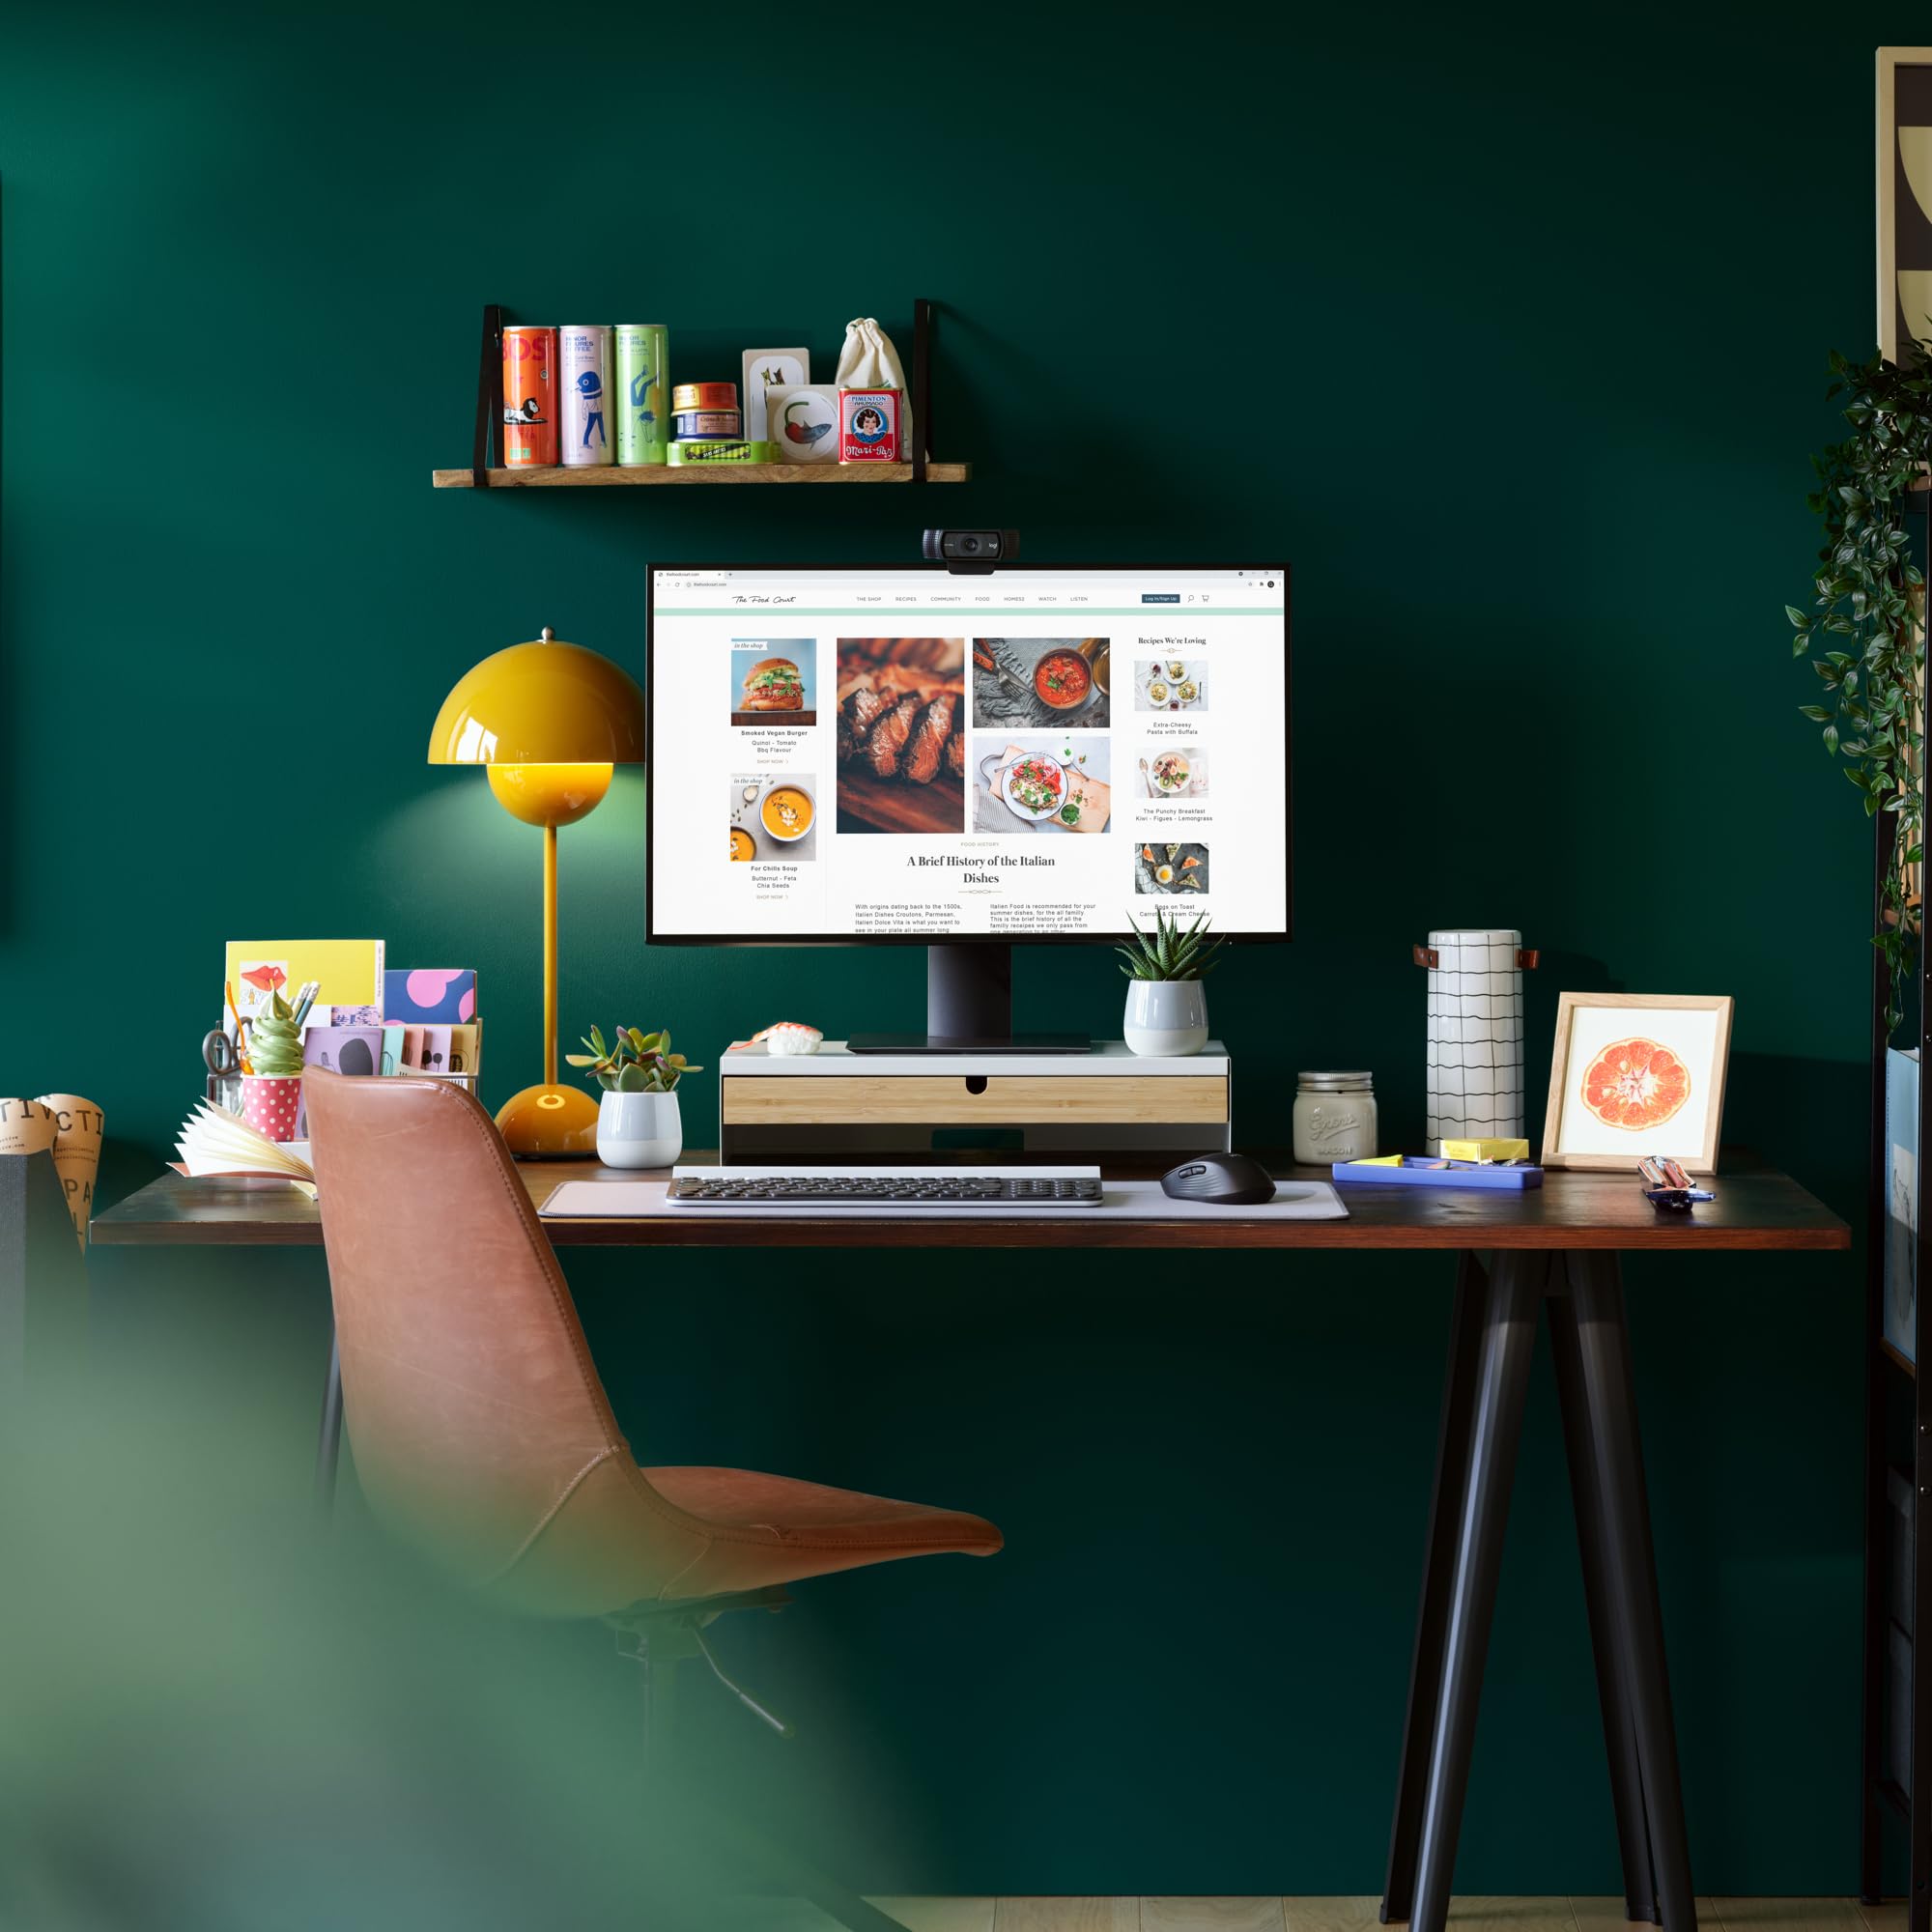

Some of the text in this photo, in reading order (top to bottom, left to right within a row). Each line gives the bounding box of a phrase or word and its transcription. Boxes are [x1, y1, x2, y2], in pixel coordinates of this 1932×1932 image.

[503, 336, 548, 361] OS
[731, 595, 797, 604] The Food Court
[1138, 637, 1164, 646] Recipes
[1183, 637, 1208, 646] Loving
[907, 856, 1056, 869] A Brief History of the Italian
[963, 872, 1000, 884] Dishes
